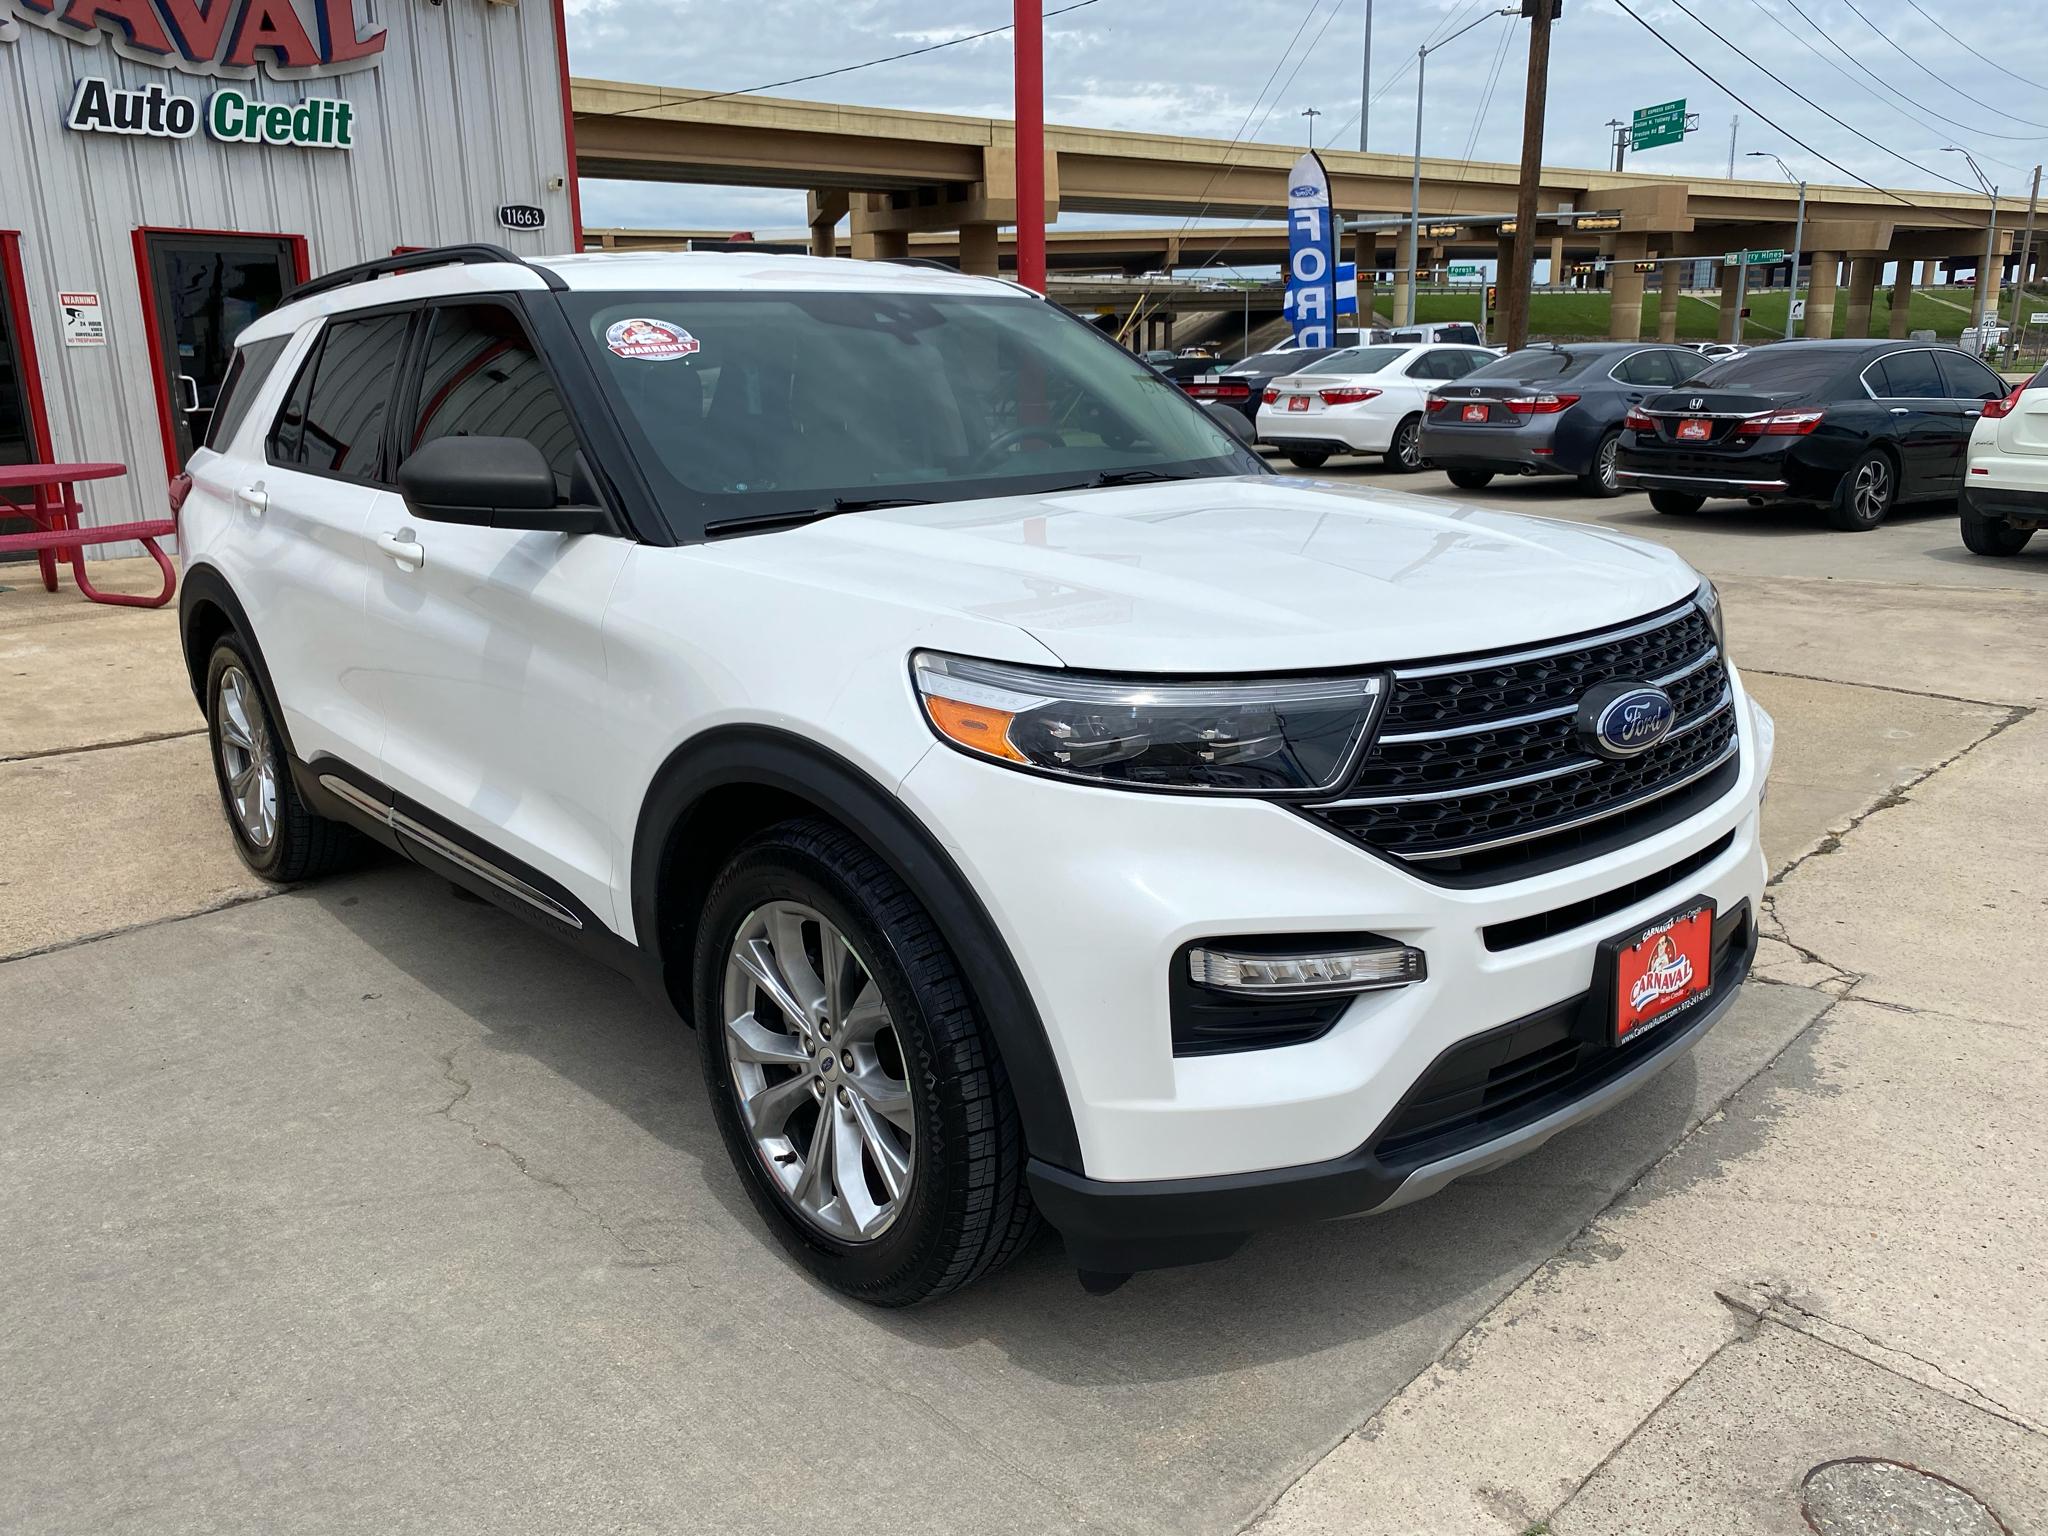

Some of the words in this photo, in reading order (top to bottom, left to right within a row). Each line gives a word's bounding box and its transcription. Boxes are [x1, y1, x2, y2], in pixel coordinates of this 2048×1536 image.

[74, 80, 195, 134] Auto
[213, 92, 353, 145] Credit
[506, 209, 540, 225] 11663
[1762, 251, 1782, 259] Hines
[62, 295, 97, 305] WARNING
[620, 343, 692, 356] WARRANTY
[1622, 701, 1662, 741] Ford
[1642, 917, 1675, 943] CARNAVAL
[1631, 960, 1692, 1003] CARNAVAL
[1660, 996, 1671, 1004] Auto
[1671, 989, 1684, 1000] Credit
[1621, 1008, 1678, 1044] www.CarnavalAutos.com
